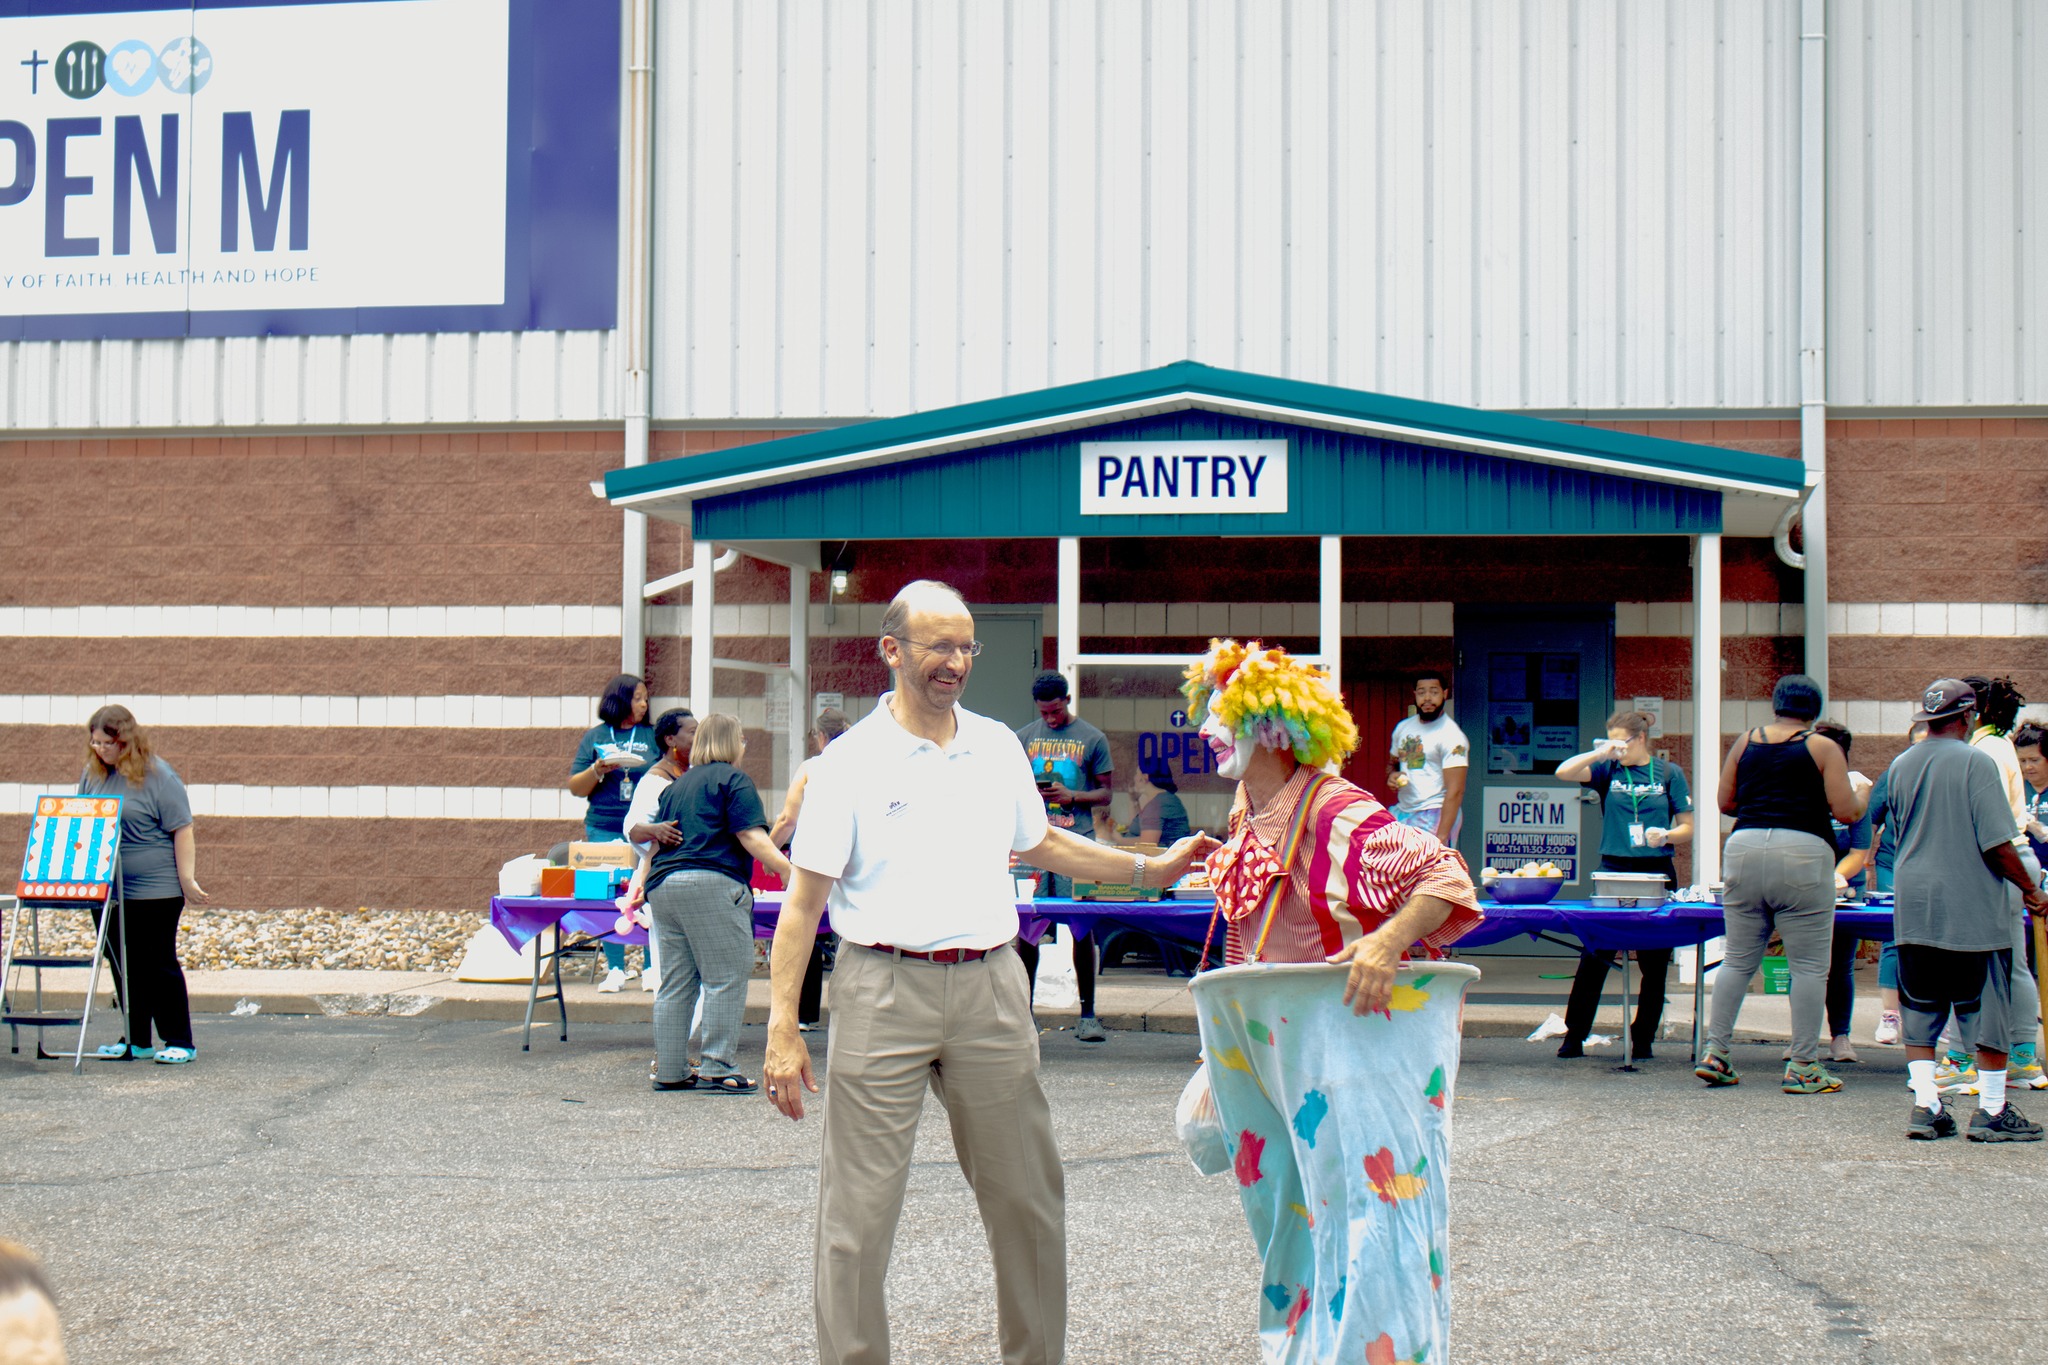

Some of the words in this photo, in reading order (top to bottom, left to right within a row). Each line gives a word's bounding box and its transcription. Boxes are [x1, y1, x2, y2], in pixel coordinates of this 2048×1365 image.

[221, 109, 310, 252] M
[22, 274, 46, 288] OF
[126, 269, 205, 286] HEALTH
[213, 270, 256, 284] AND
[264, 267, 319, 283] HOPE
[1098, 455, 1267, 498] PANTRY
[1499, 802, 1544, 824] OPEN
[1550, 803, 1564, 824] M
[1488, 833, 1510, 845] FOOD
[1511, 834, 1546, 846] PANTRY
[1547, 834, 1576, 846] HOURS
[1496, 845, 1520, 853] M-TH
